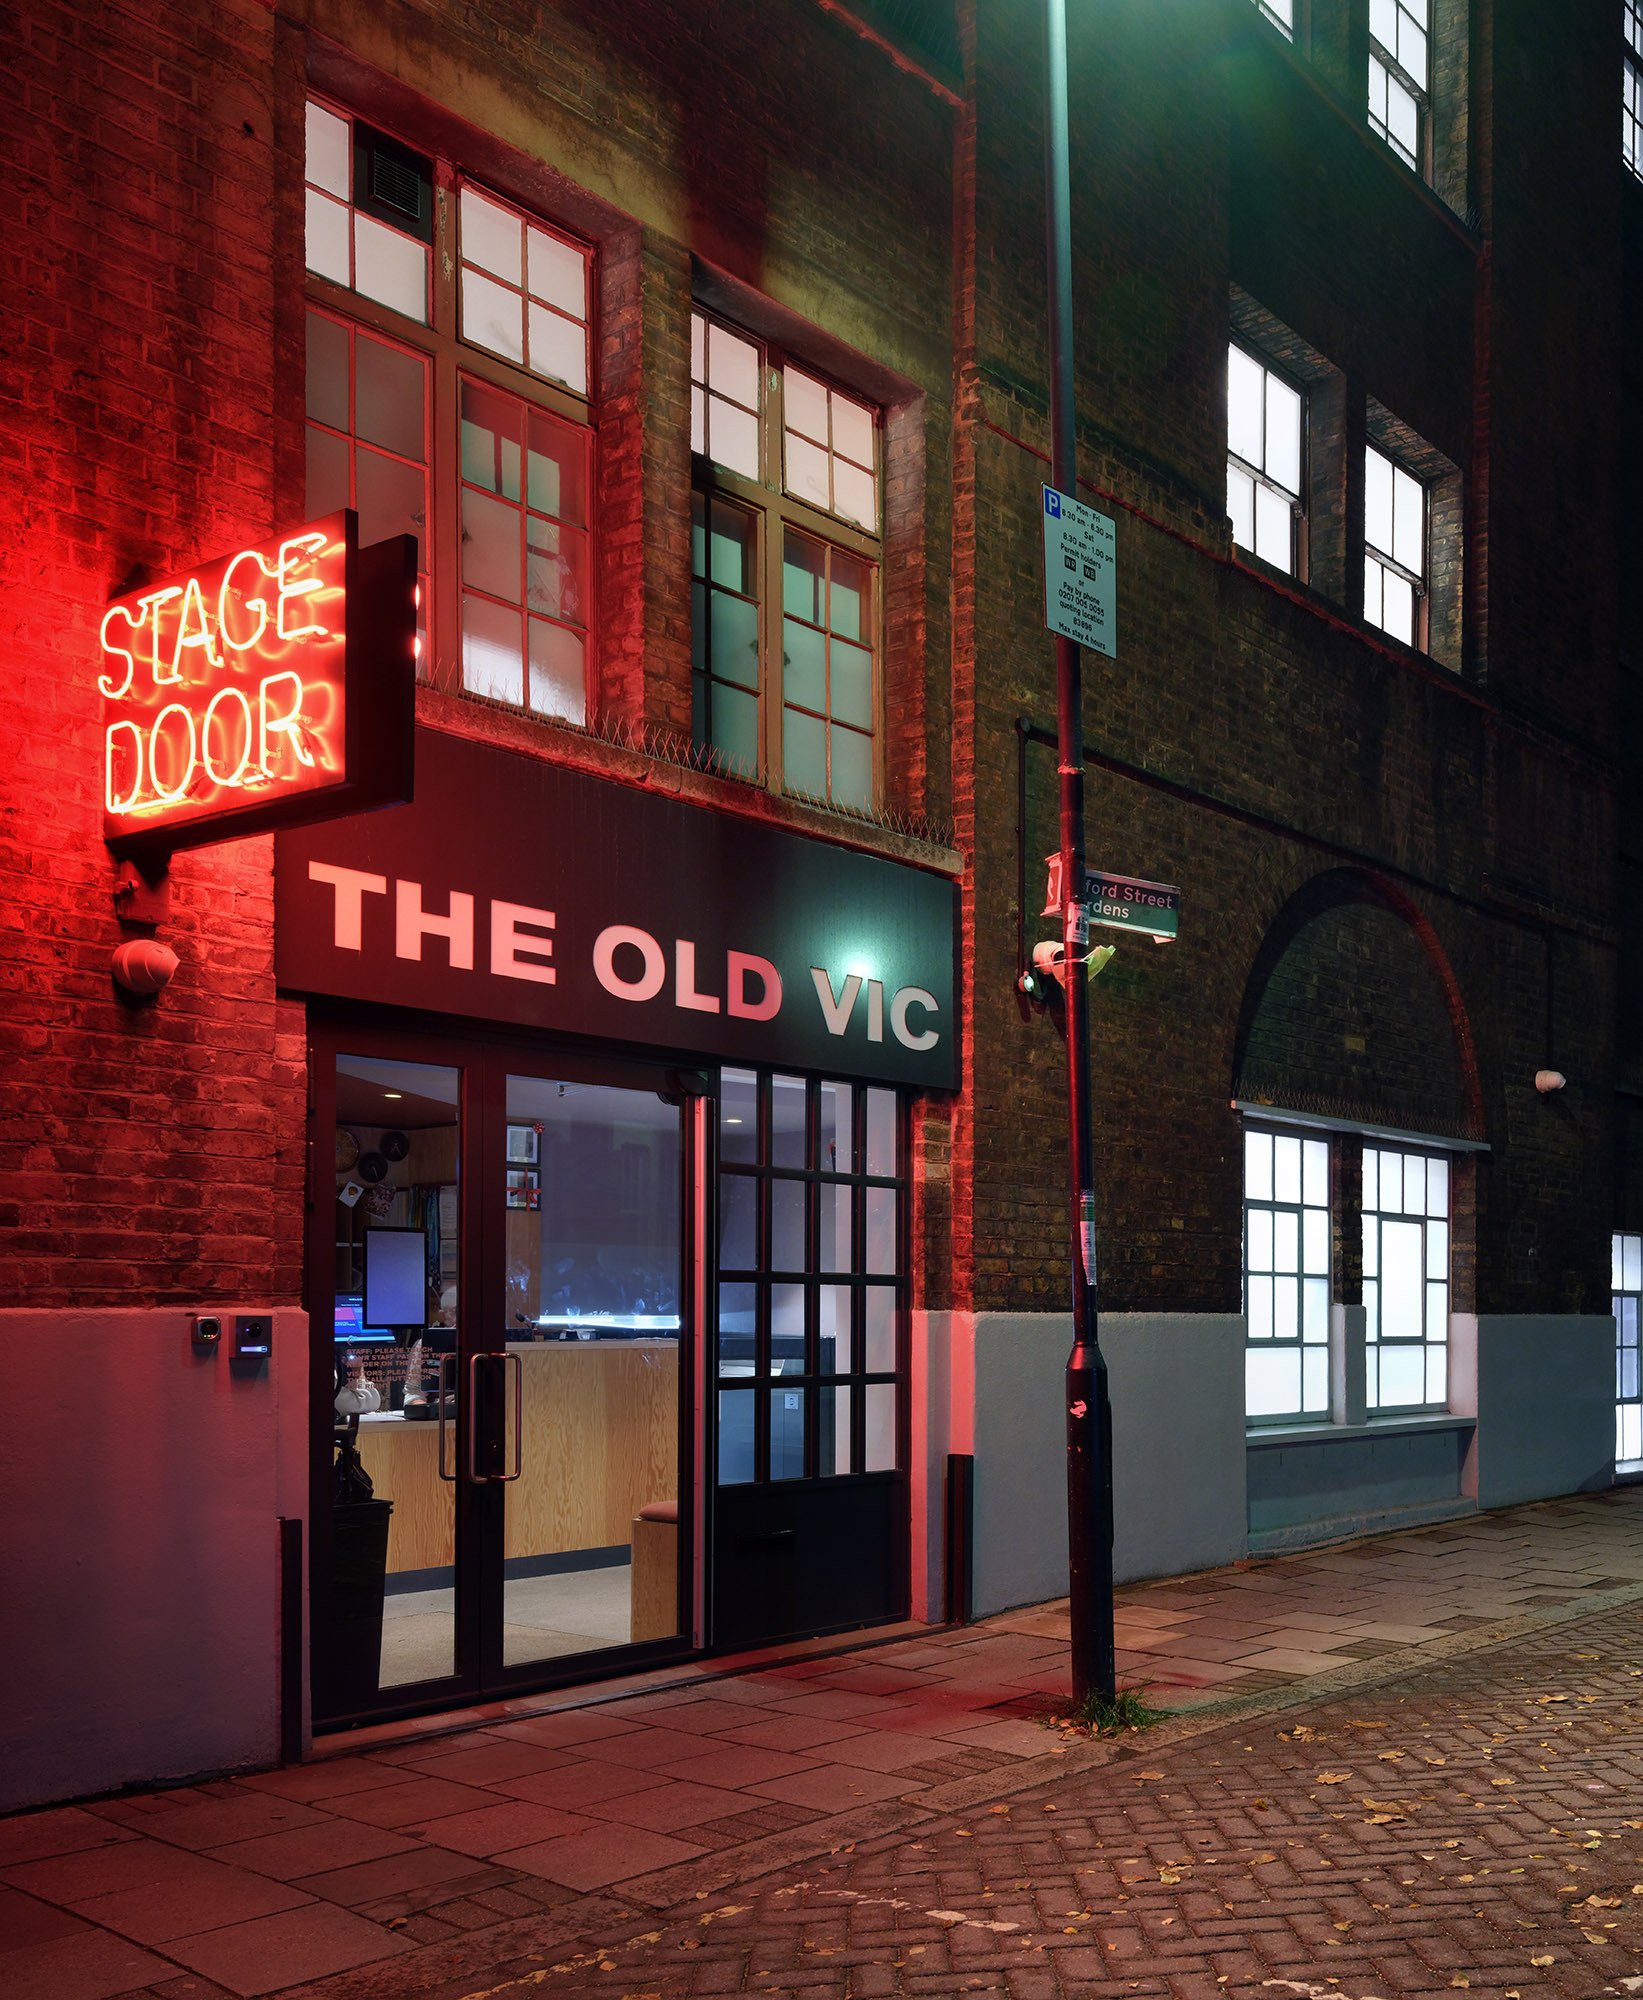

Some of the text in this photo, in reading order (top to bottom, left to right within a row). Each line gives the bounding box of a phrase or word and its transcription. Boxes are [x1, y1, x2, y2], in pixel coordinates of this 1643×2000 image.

[1048, 492, 1058, 513] P
[1077, 505, 1089, 517] Mon
[1062, 509, 1076, 521] 8.30
[1077, 517, 1086, 526] am
[1105, 532, 1113, 541] pm
[1084, 531, 1094, 542] Sat
[1060, 542, 1101, 569] Permit holders
[1063, 532, 1077, 544] 8.30
[1078, 541, 1087, 550] am
[1092, 547, 1104, 558] 1.00
[1105, 554, 1114, 563] pm
[1059, 589, 1074, 602] 0207
[1076, 597, 1088, 608] 005
[1063, 581, 1100, 606] Pay by phone
[98, 531, 329, 699] STAGE
[1060, 601, 1104, 625] quoting location
[1059, 622, 1071, 633] Max
[1072, 629, 1084, 641] stay
[1091, 636, 1106, 650] hours
[105, 670, 315, 814] DOOR
[1086, 880, 1172, 909] ford Street
[1088, 900, 1130, 919] rdens
[308, 860, 941, 1052] THE OLD VIC
